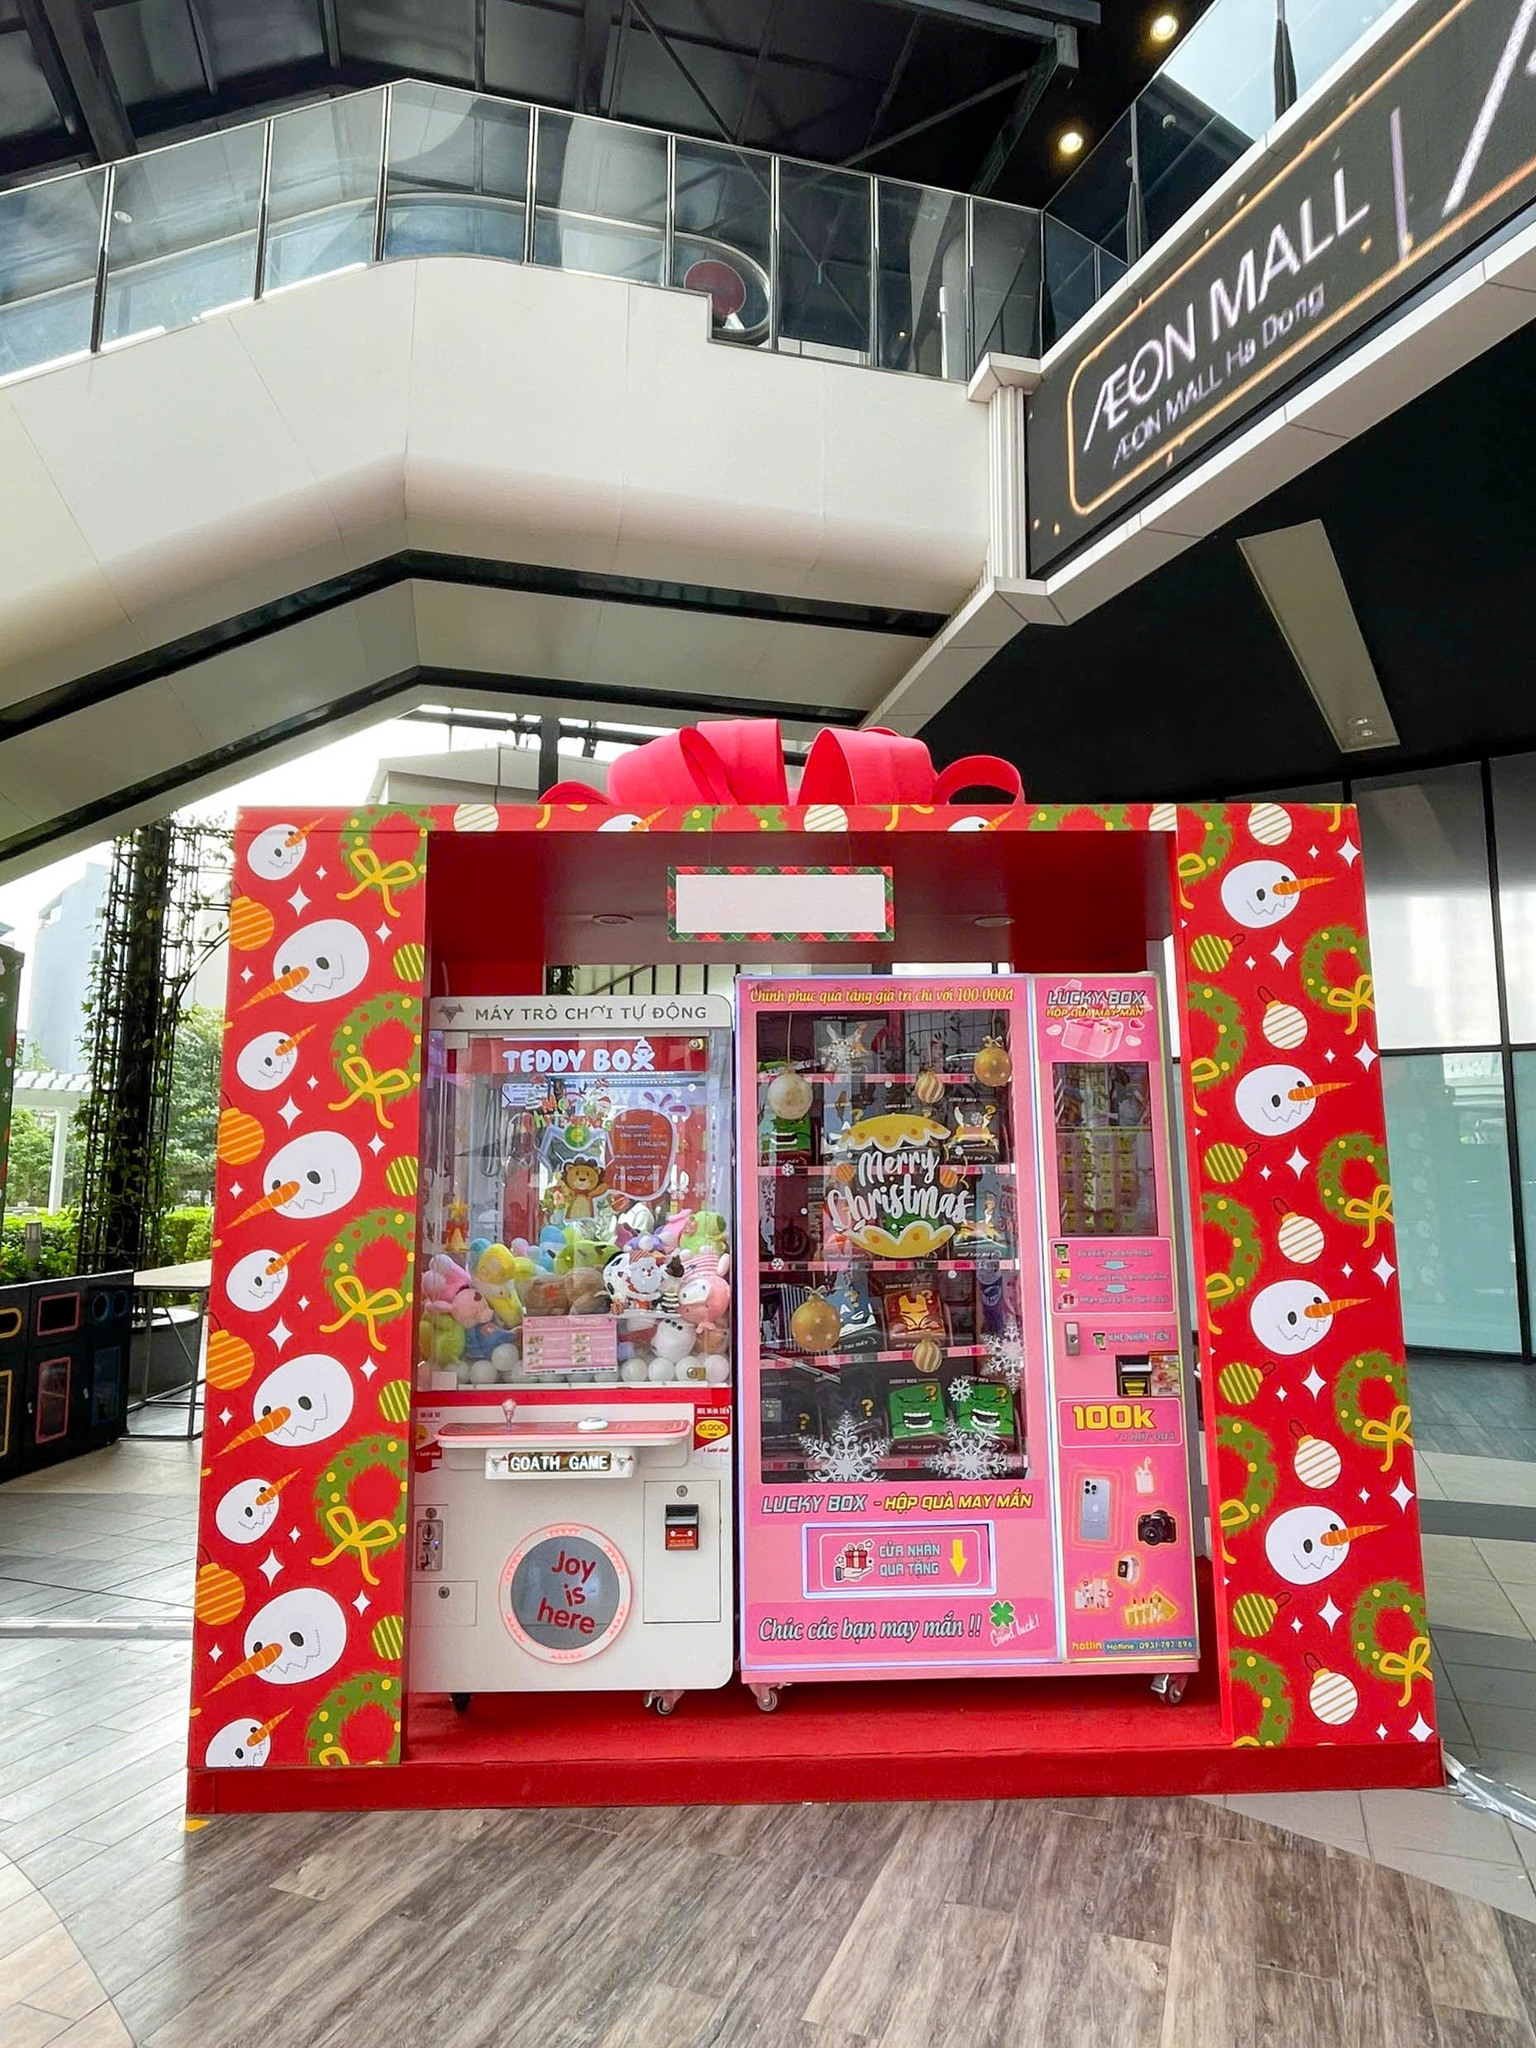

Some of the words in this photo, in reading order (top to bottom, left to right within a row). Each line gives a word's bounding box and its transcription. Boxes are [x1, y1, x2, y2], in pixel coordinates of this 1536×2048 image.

[1210, 167, 1370, 342] MALL
[1166, 366, 1223, 423] MALL
[475, 1005, 514, 1020] MÁY
[521, 1004, 557, 1020] TRÒ
[621, 1003, 646, 1021] TỰ
[652, 1002, 706, 1021] ĐỘNG
[1047, 990, 1104, 1005] LUCKY
[1107, 990, 1146, 1005] BOX
[502, 1048, 586, 1072] TEDDY
[593, 1043, 655, 1072] BOX
[858, 1149, 940, 1187] Merry
[827, 1173, 974, 1232] Christmas
[1072, 1404, 1156, 1430] 100k
[510, 1455, 561, 1471] GOATH
[568, 1455, 609, 1471] GAME
[761, 1494, 823, 1514] LUCKY
[826, 1494, 868, 1513] BOX
[884, 1491, 918, 1515] HỘP
[920, 1490, 954, 1514] QUÀ
[957, 1494, 994, 1510] MAY
[995, 1488, 1033, 1510] MẮN
[551, 1551, 597, 1584] Joy
[564, 1583, 586, 1606] is
[536, 1597, 596, 1635] here
[758, 1616, 804, 1641] Chúc
[807, 1617, 838, 1640] các
[841, 1616, 876, 1643] bạn
[880, 1620, 919, 1643] may
[923, 1611, 964, 1638] mắn
[1106, 1642, 1135, 1652] Hotline
